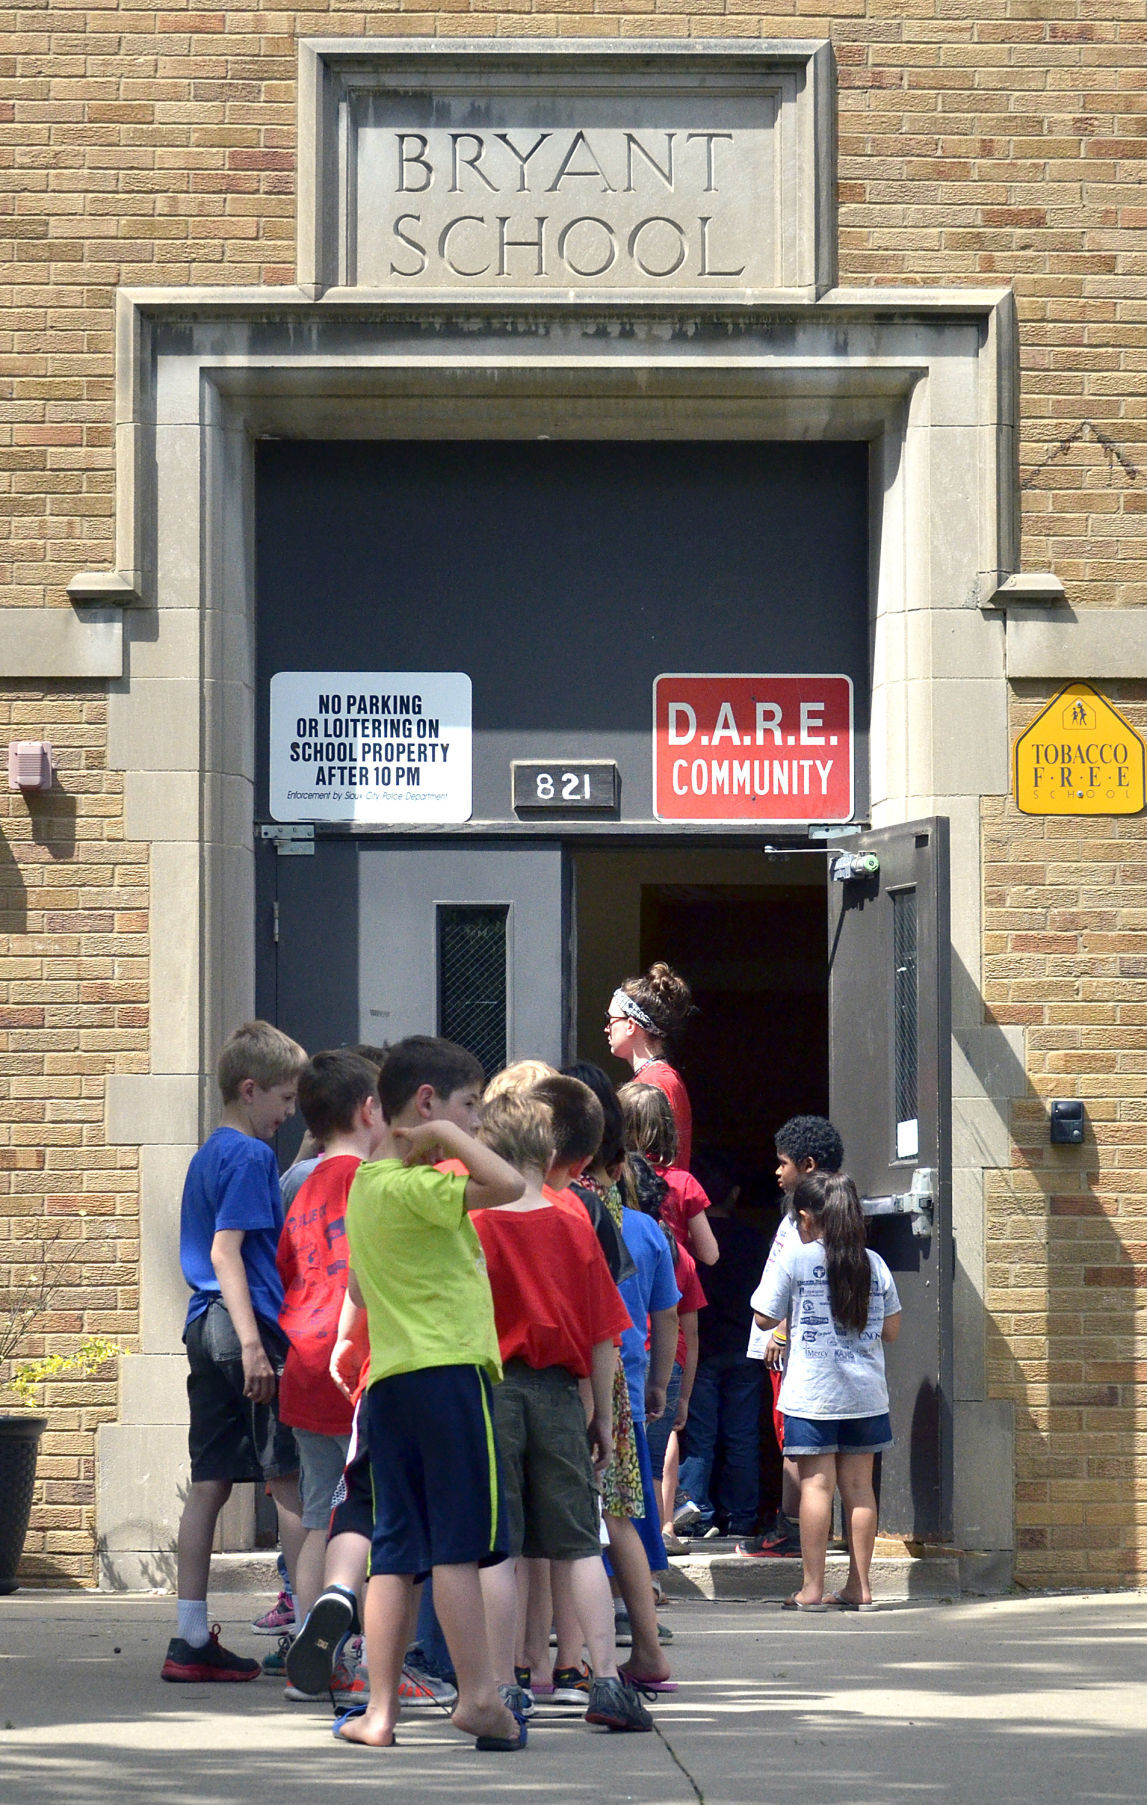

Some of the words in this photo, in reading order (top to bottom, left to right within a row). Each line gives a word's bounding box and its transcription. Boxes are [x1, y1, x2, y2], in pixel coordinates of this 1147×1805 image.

[394, 130, 734, 194] BRYANT
[390, 213, 746, 278] SCHOOL
[318, 694, 342, 715] NO
[346, 694, 423, 716] PARKING
[296, 717, 319, 738] OR
[323, 718, 413, 739] LOITERING
[416, 718, 440, 739] ON
[667, 701, 839, 747] D.A.R.E.
[289, 741, 358, 763] SCHOOL
[361, 742, 450, 763] PROPERTY
[1031, 743, 1129, 765] TOBACCO
[314, 765, 369, 786] AFTER
[373, 766, 392, 786] 10
[395, 766, 421, 787] PM
[535, 772, 592, 801] 821
[672, 758, 834, 796] COMMUNITY
[287, 790, 332, 800] Enforcement
[332, 790, 343, 802] by
[344, 790, 363, 801] Sioux
[365, 791, 380, 802] City
[382, 791, 404, 801] Police
[405, 791, 449, 802] Department
[1032, 789, 1130, 799] SCHOOL
